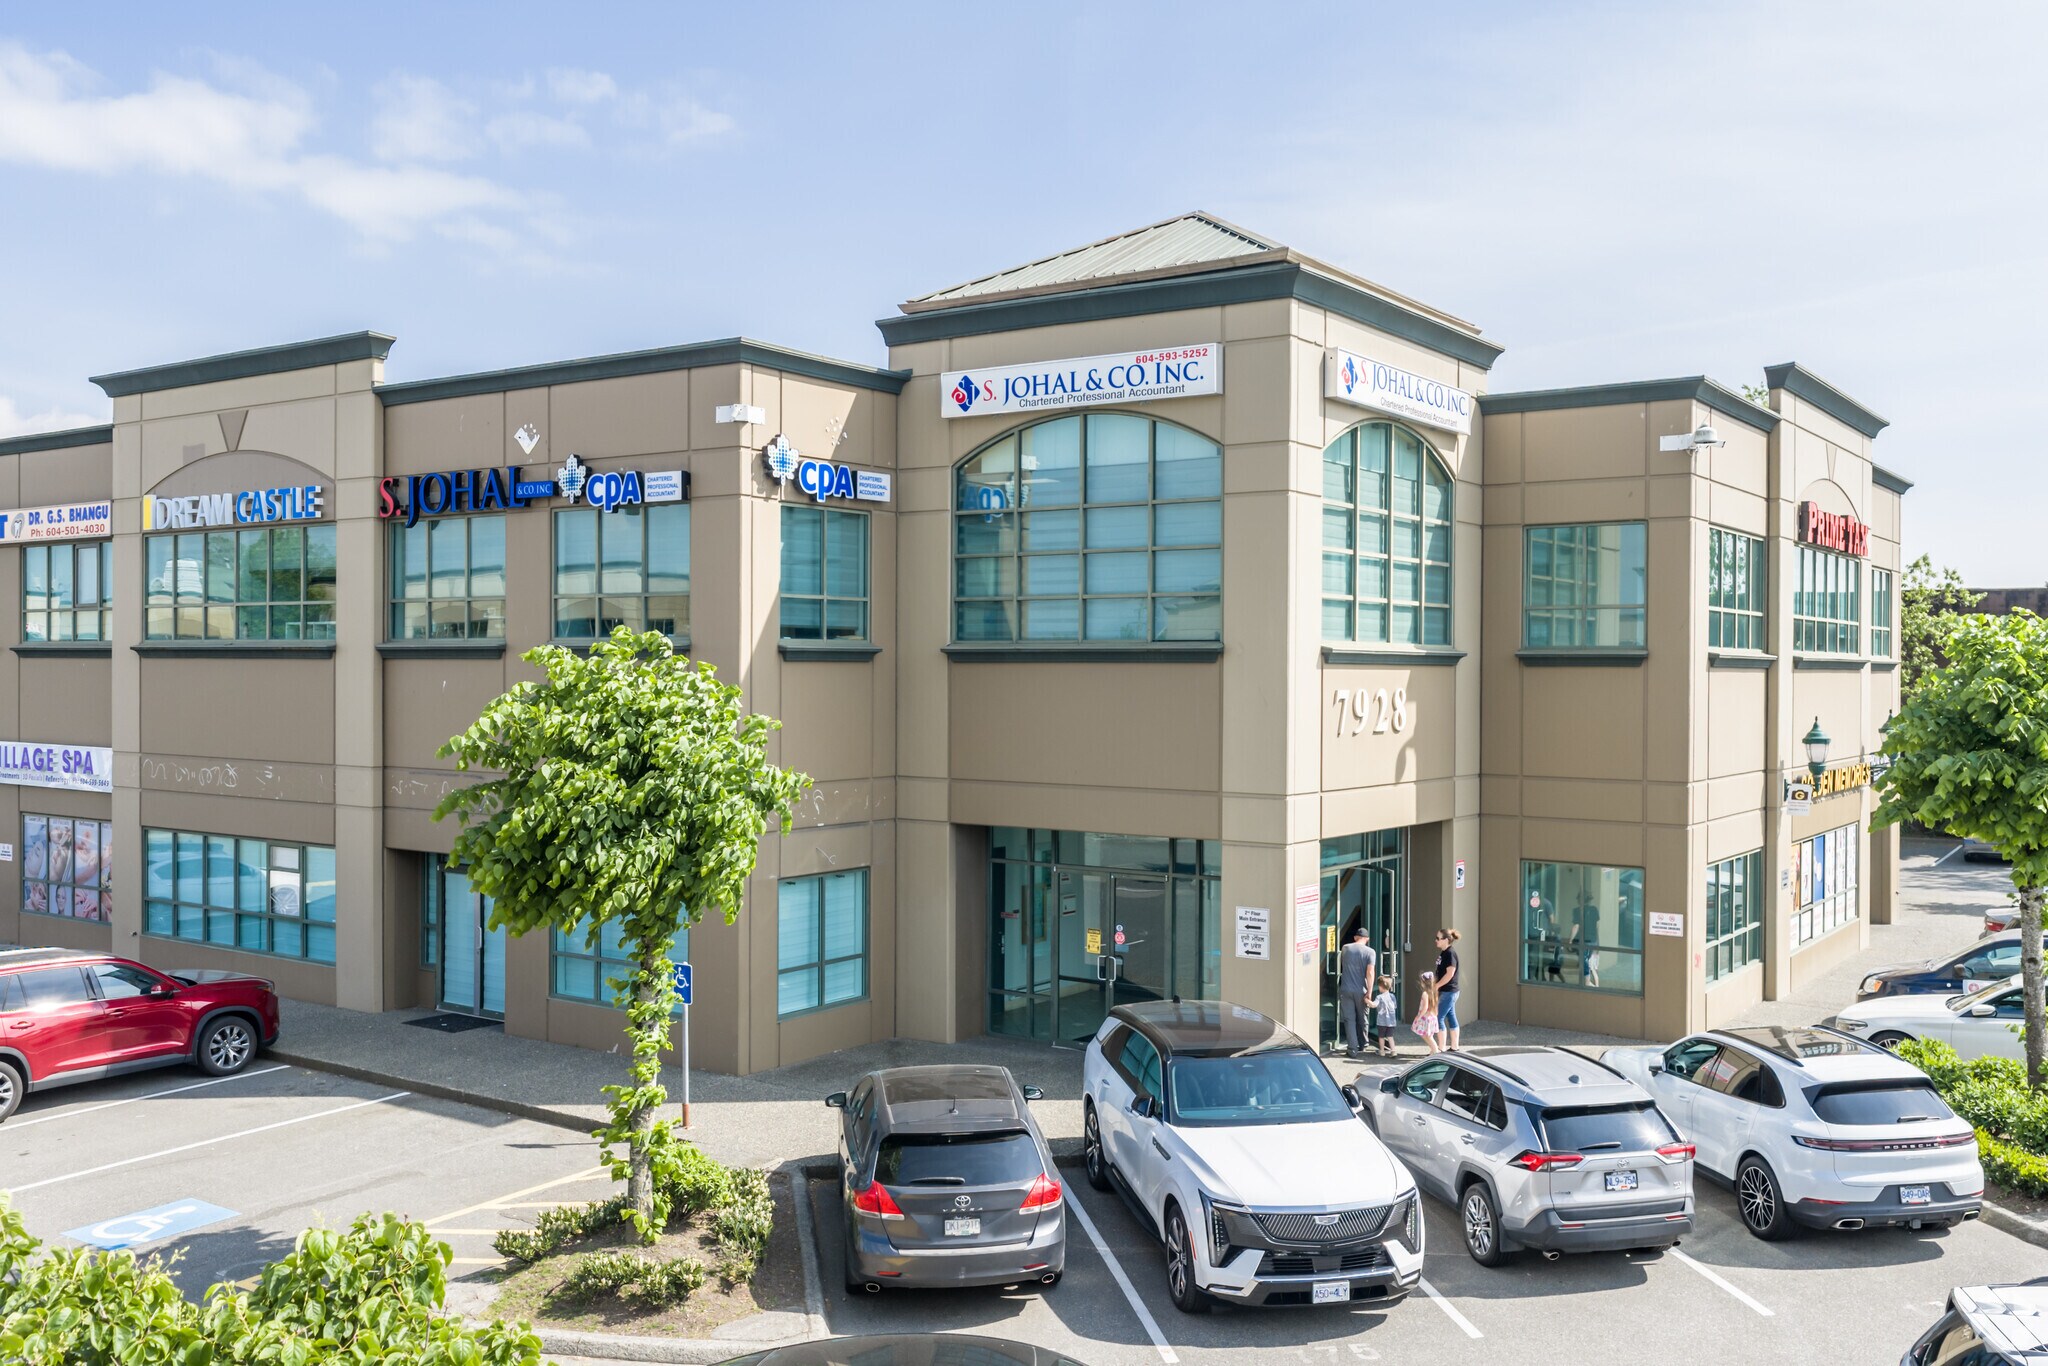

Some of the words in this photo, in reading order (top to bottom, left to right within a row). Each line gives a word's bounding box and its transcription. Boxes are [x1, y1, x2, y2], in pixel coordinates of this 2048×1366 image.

[1135, 348, 1209, 365] 604-593-5252
[982, 379, 997, 401] S.
[1003, 370, 1082, 406] JOHAL
[1155, 361, 1204, 385] INC.
[1019, 395, 1064, 408] Chartered
[1066, 389, 1126, 404] Professional
[1128, 384, 1186, 398] Accountant
[1360, 360, 1369, 385] S.
[1447, 387, 1468, 416] INC.
[1380, 397, 1404, 413] Chartered
[1405, 404, 1432, 420] Professional
[1432, 413, 1458, 427] Accountant
[587, 470, 642, 513] CPA
[647, 475, 673, 483] CHARTERED
[799, 461, 854, 503] CPA
[859, 475, 883, 483] CHARTERED
[859, 482, 888, 490] PROFESSIONAL
[859, 489, 885, 497] ACCOUNTANT
[235, 485, 323, 524] CASTLE
[379, 477, 401, 518] S.
[405, 466, 526, 528] JOHAL
[28, 511, 44, 526] DR.
[47, 509, 65, 524] G.S.
[69, 505, 109, 522] BHANGU
[1807, 501, 1846, 551] PRIME
[1846, 515, 1869, 556] TAX
[30, 529, 44, 538] Ph:
[46, 523, 105, 537] 604-501-4030
[1333, 688, 1407, 737] 7928
[62, 750, 94, 775] SPA
[1834, 763, 1871, 792] MEMORIES
